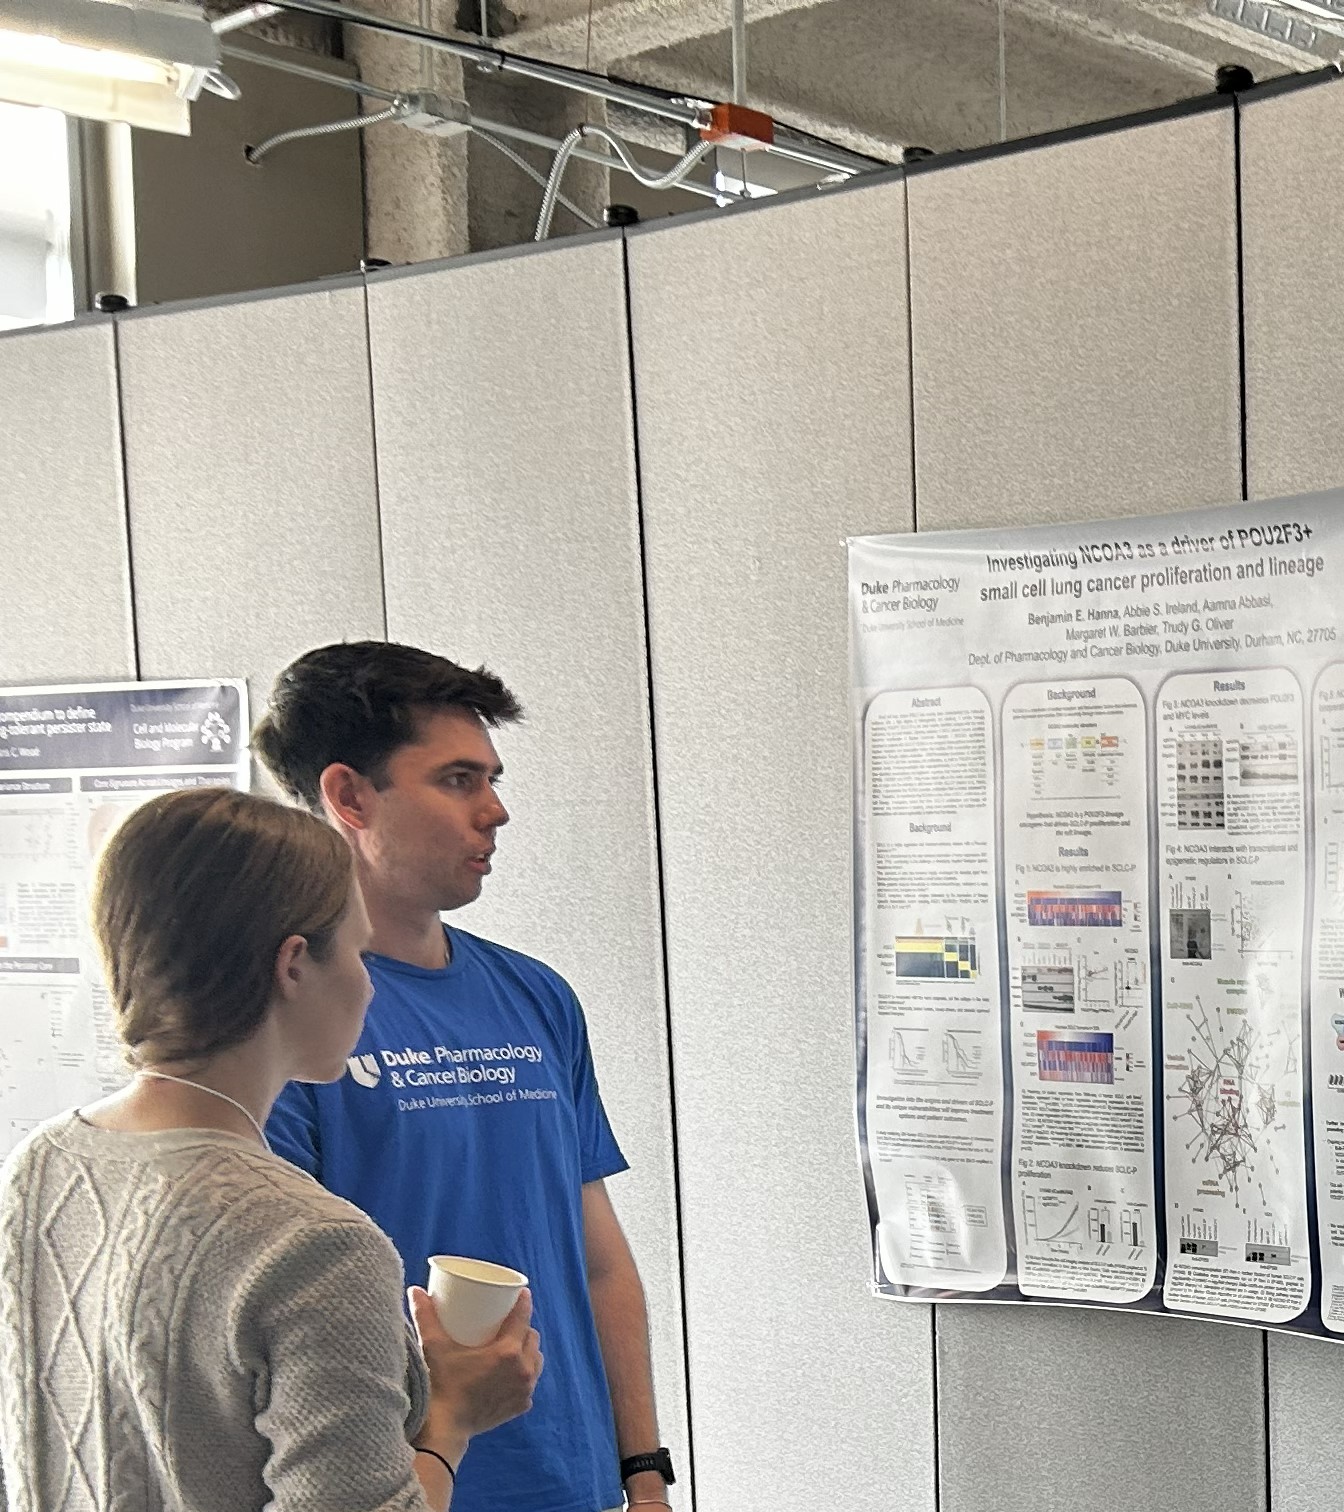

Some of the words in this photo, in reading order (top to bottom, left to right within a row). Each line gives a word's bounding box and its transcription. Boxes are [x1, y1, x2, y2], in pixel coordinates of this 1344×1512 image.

[987, 548, 1078, 573] Investigating
[1079, 541, 1134, 565] NCOA3
[1138, 541, 1155, 558] as
[1158, 540, 1169, 557] a
[1171, 534, 1215, 555] driver
[1219, 531, 1236, 550] of
[1236, 522, 1313, 549] POU2F3+
[861, 581, 889, 596] Duke
[892, 575, 960, 593] Pharmacology
[980, 580, 1018, 602] small
[1022, 578, 1047, 598] cell
[1051, 576, 1082, 598] lung
[1087, 574, 1137, 593] cancer
[1141, 561, 1231, 592] proliferation
[1237, 557, 1264, 579] and
[1269, 554, 1325, 578] lineage
[870, 599, 901, 613] Cancer
[903, 595, 939, 612] Biology
[1028, 611, 1073, 628] Benjamin
[1070, 645, 1087, 659] and
[1090, 643, 1124, 658] Cancer
[1048, 688, 1096, 702] Background
[1213, 680, 1245, 692] Results
[381, 1047, 434, 1068] Duke
[434, 1042, 543, 1064] Pharmacology
[391, 1070, 406, 1089] &
[457, 1063, 516, 1085] Biology
[399, 1098, 426, 1112] Duke
[505, 1090, 518, 1101] of
